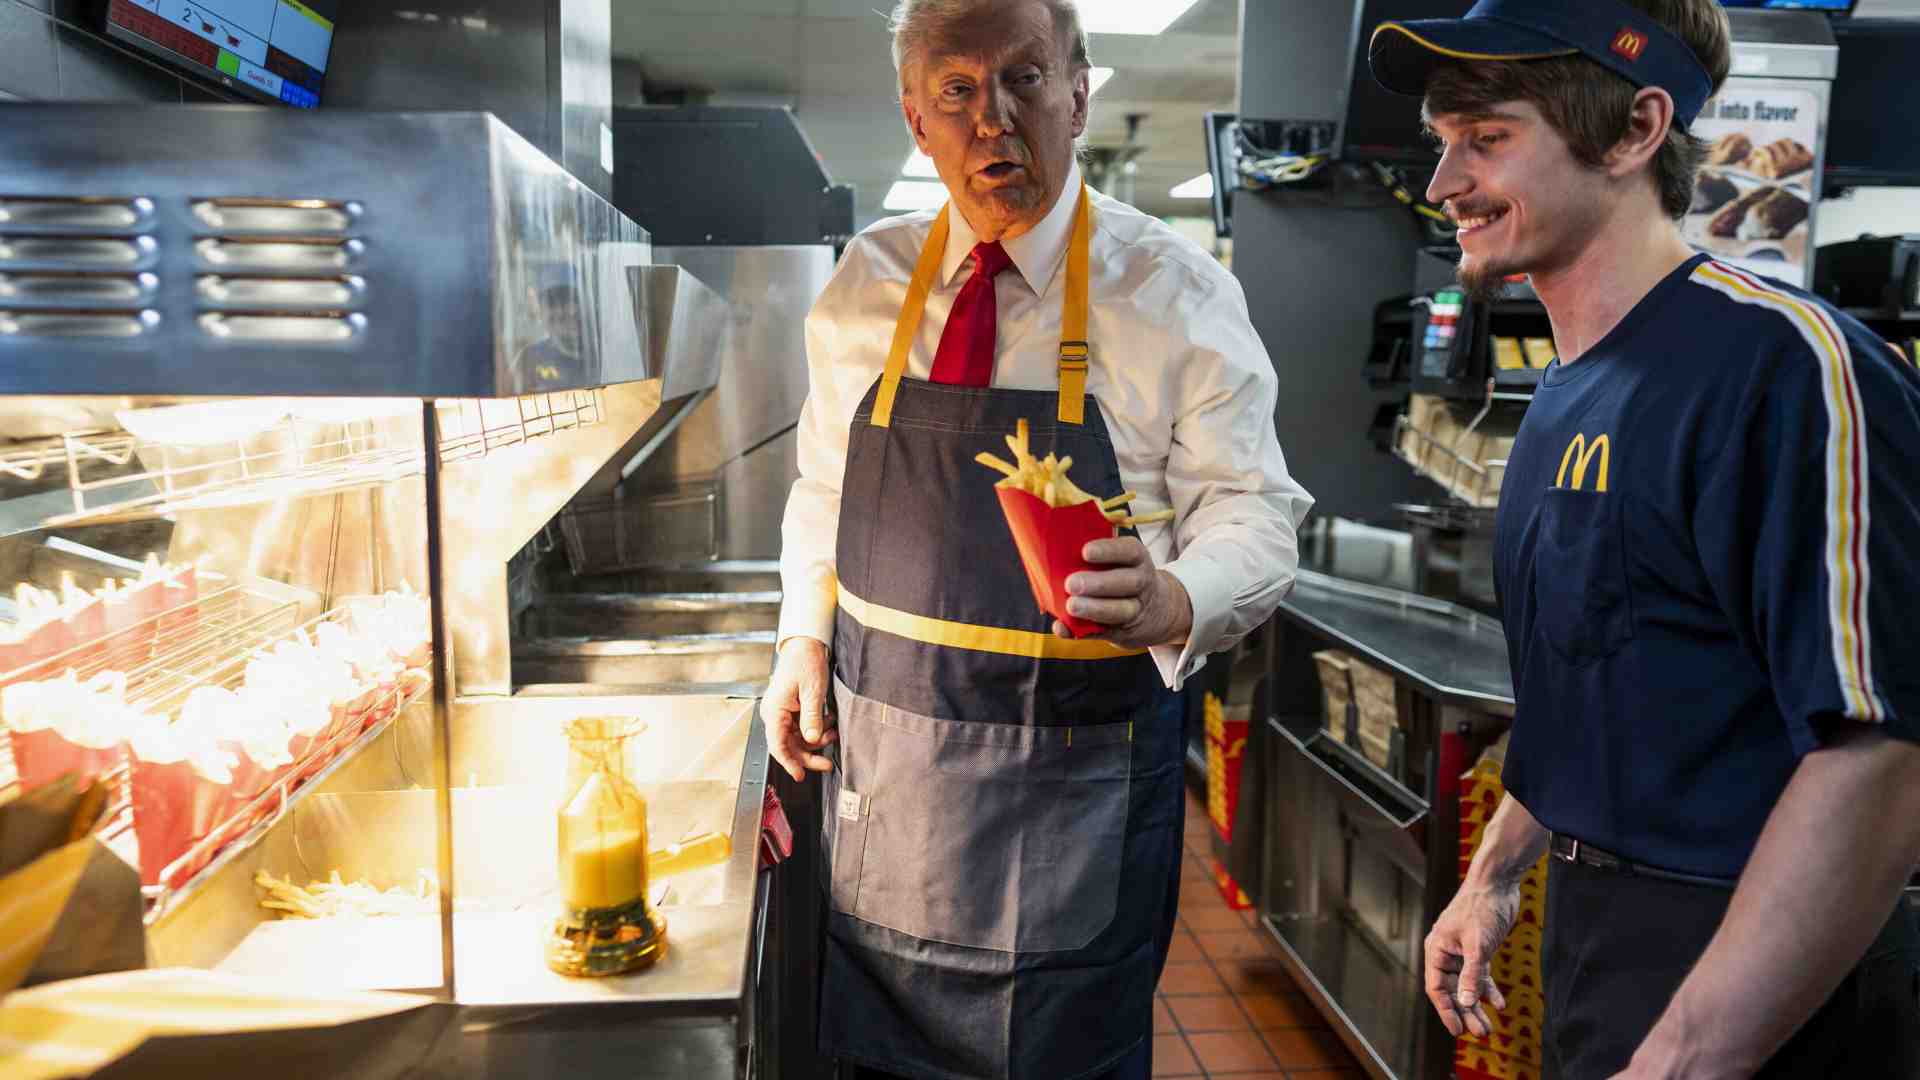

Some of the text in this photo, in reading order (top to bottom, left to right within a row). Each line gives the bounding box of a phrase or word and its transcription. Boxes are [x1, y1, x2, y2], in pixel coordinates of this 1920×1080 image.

[182, 8, 191, 22] 2
[1719, 101, 1749, 119] into
[1754, 101, 1798, 121] flavor
[1556, 432, 1609, 492] M
